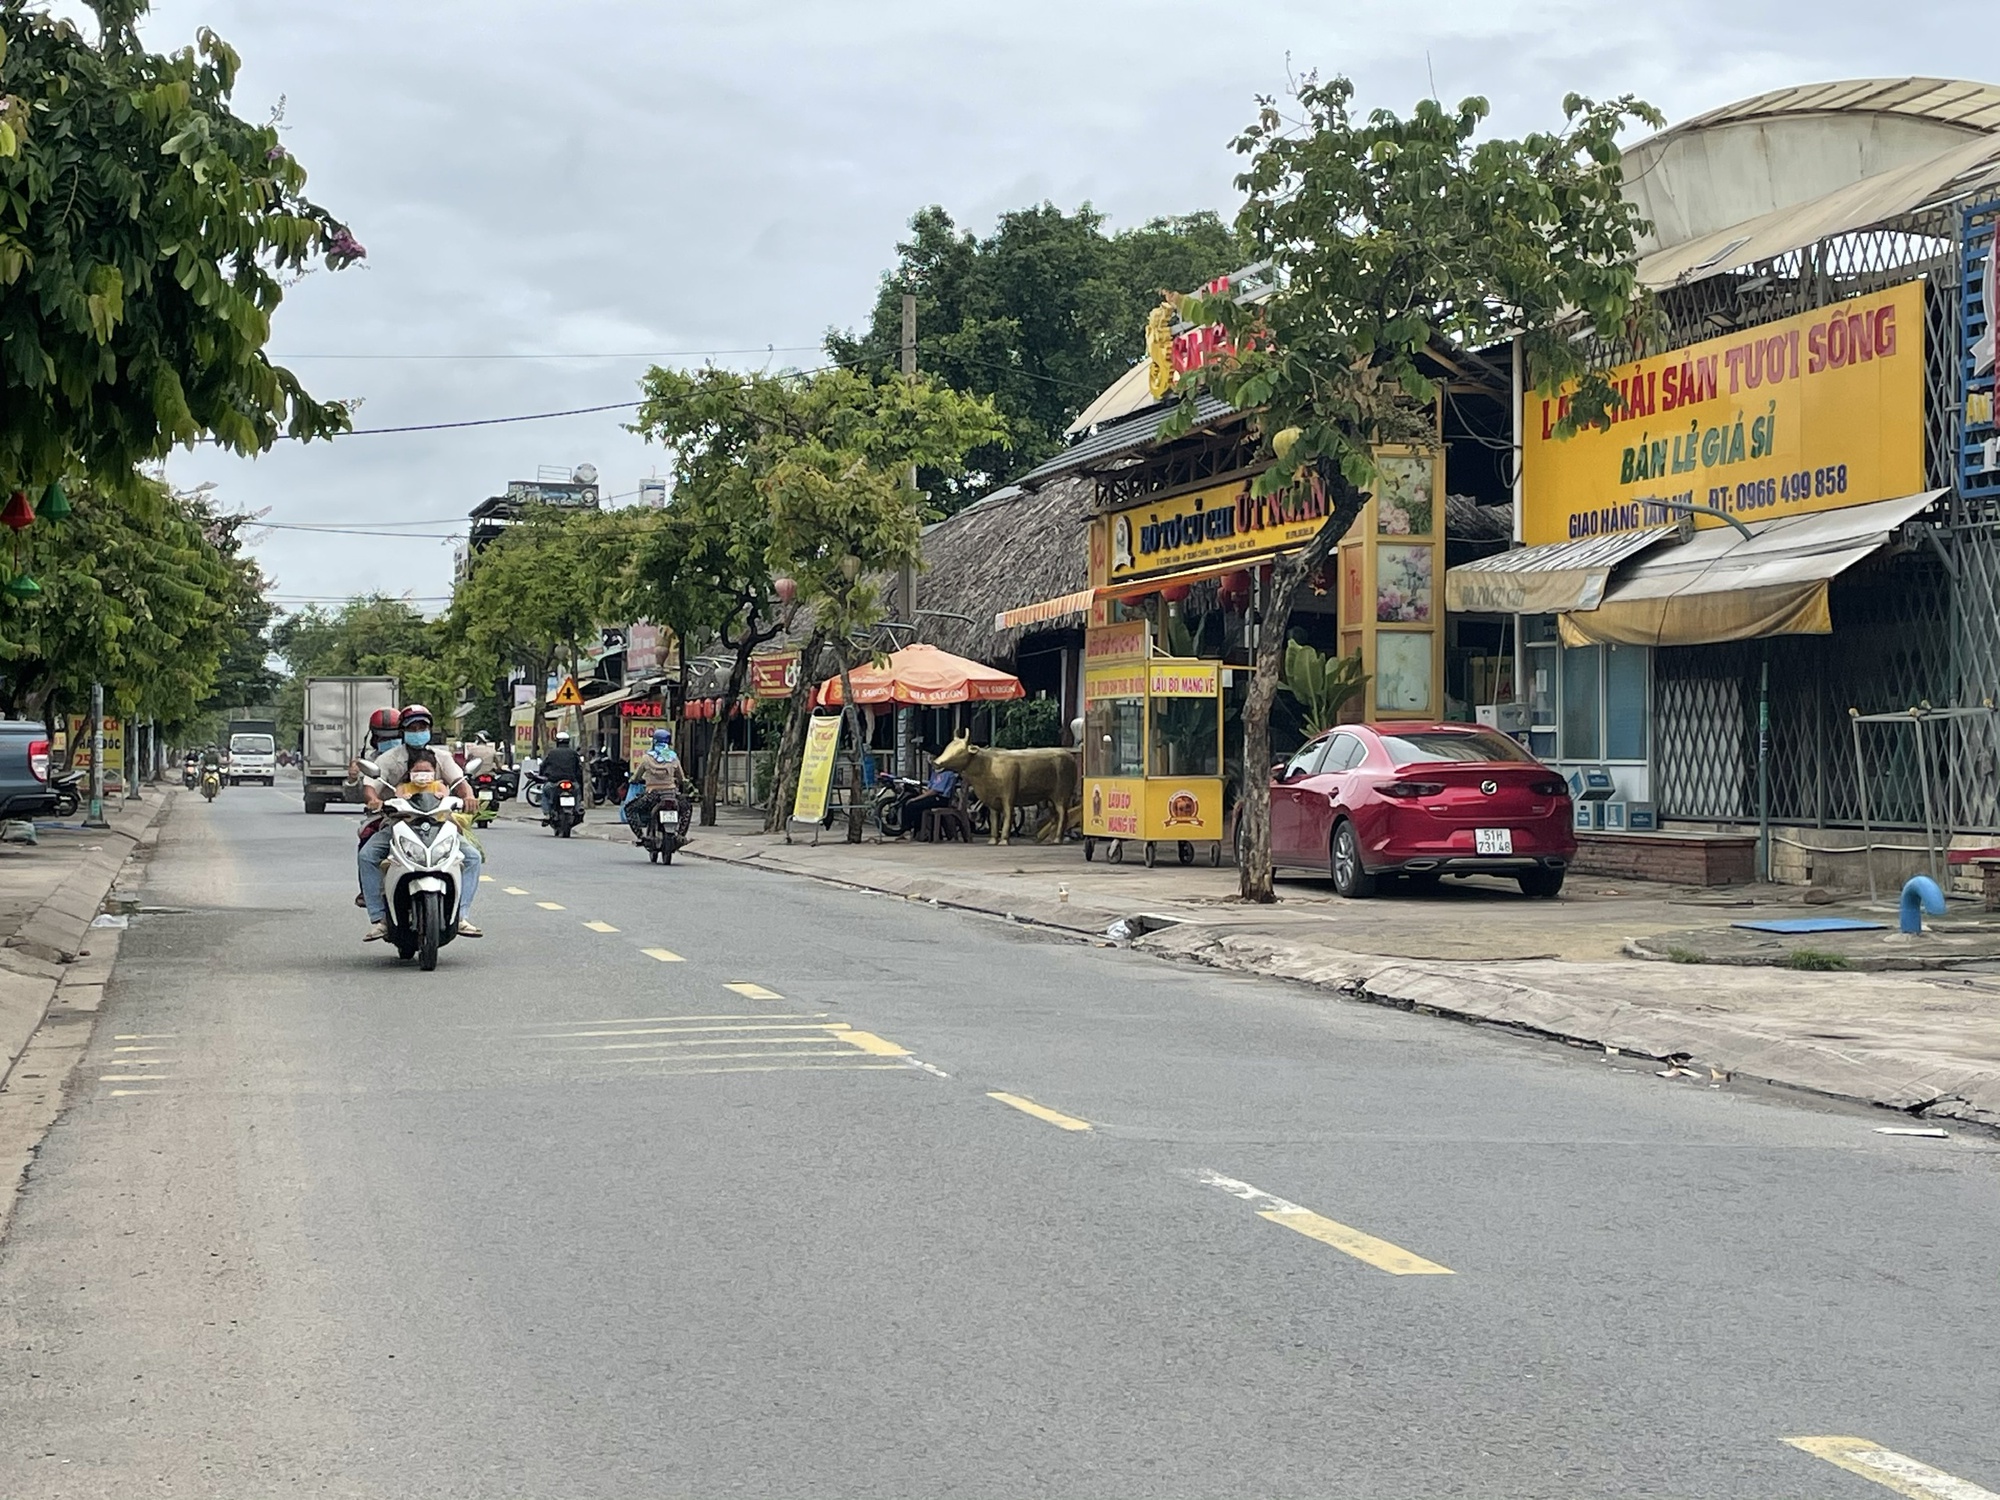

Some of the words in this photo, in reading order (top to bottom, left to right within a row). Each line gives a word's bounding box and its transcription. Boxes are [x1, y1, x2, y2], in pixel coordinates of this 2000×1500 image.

[1662, 349, 1718, 411] SẢN
[1725, 330, 1800, 395] TƯƠI
[1807, 303, 1897, 375] SỐNG
[1620, 421, 1668, 485] BÁN
[1671, 419, 1698, 475] LẺ
[1701, 411, 1746, 468] GIÁ
[1750, 399, 1777, 459] SỈ
[1205, 505, 1236, 540] CHI
[1568, 510, 1598, 539] GIAO
[1600, 501, 1638, 534] HÀNG
[1736, 478, 1776, 512] 0966
[1781, 471, 1811, 504] 499
[1815, 464, 1848, 496] 858
[1181, 677, 1204, 693] MANG
[1483, 830, 1503, 841] 51H
